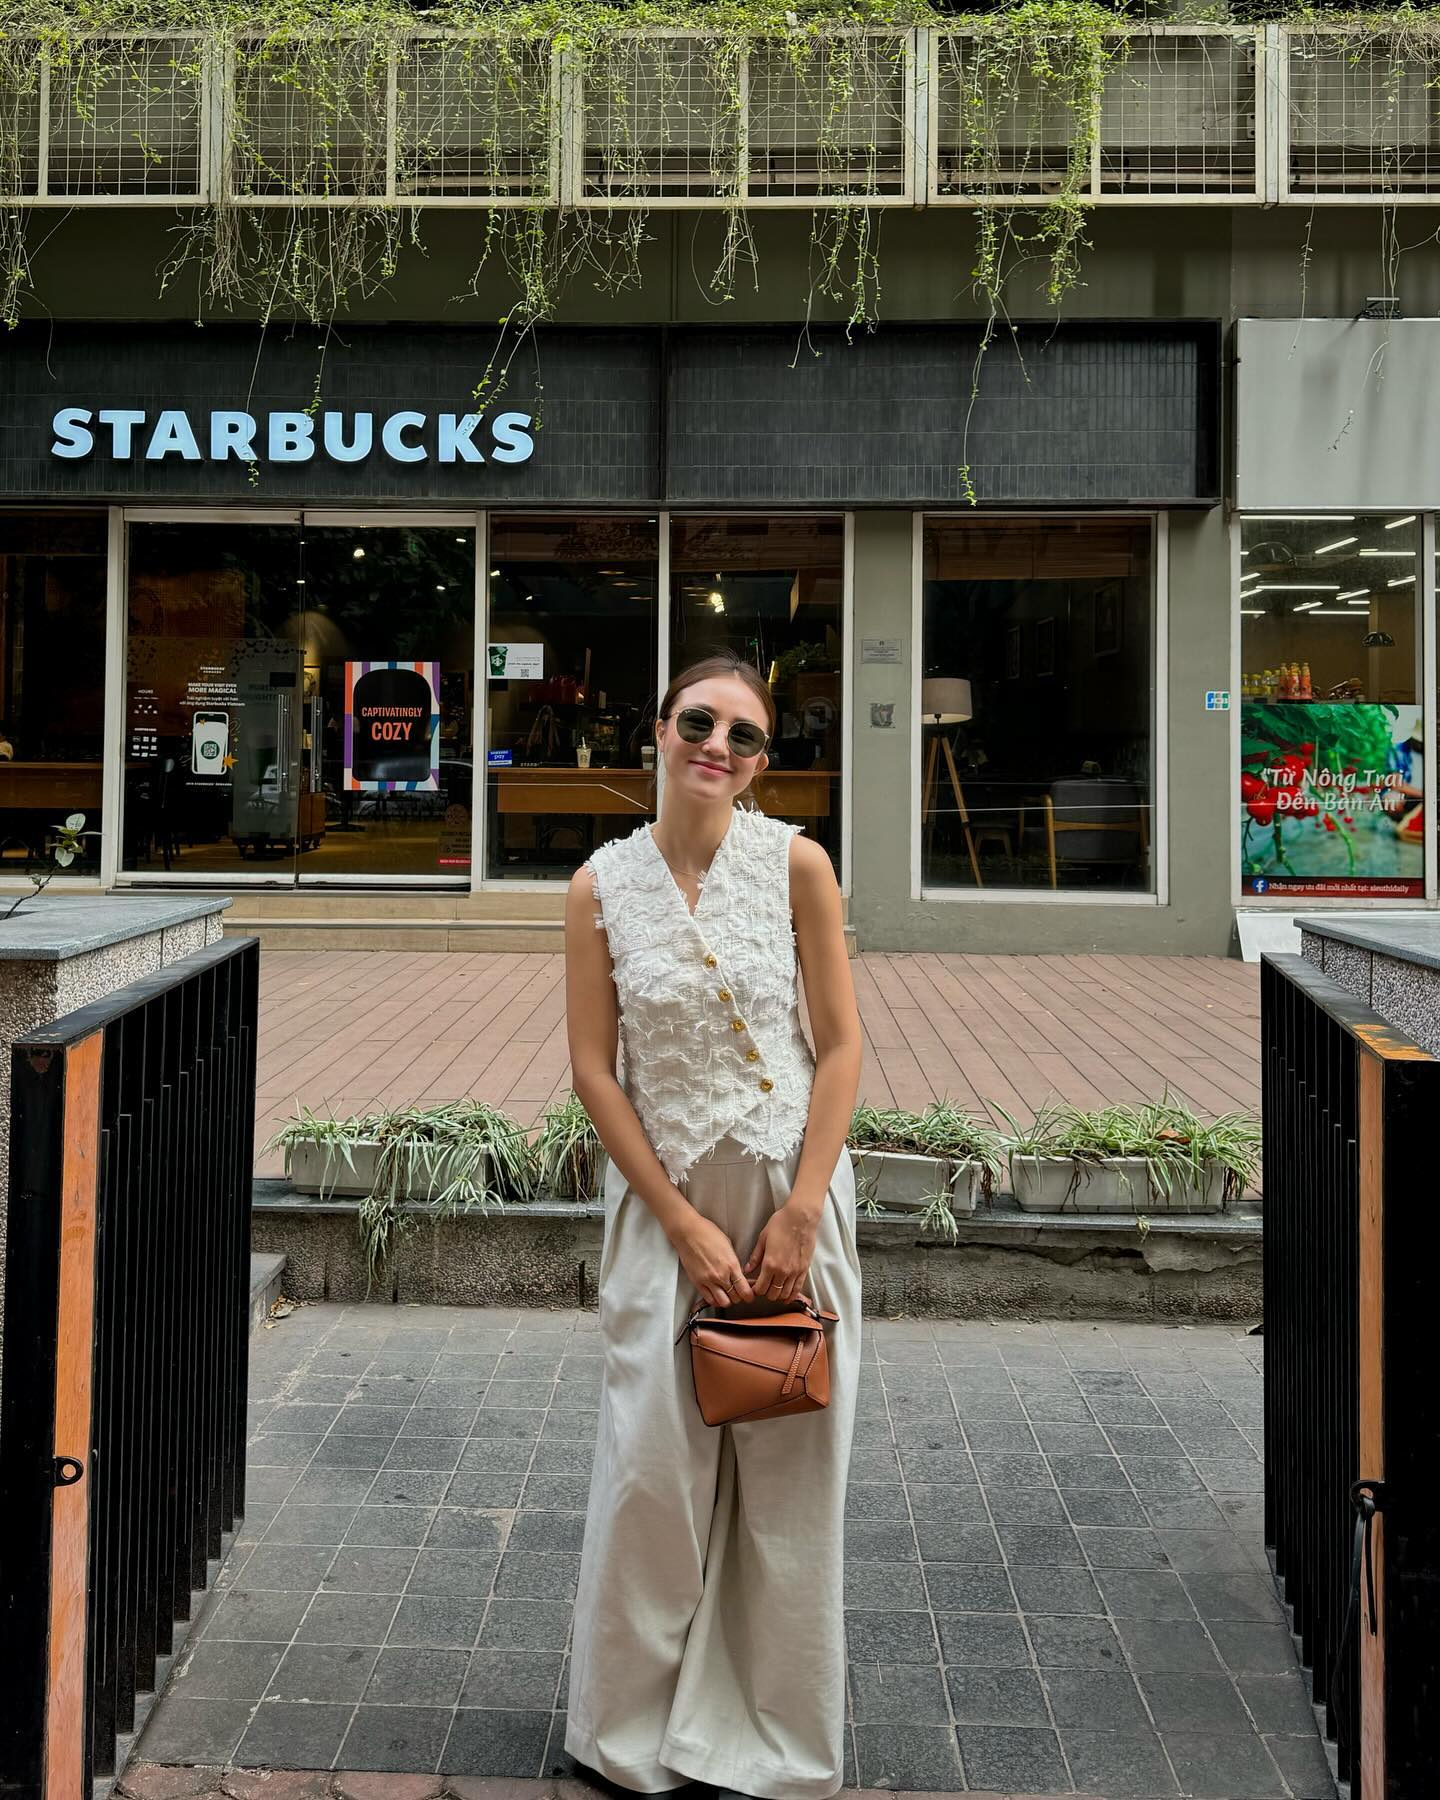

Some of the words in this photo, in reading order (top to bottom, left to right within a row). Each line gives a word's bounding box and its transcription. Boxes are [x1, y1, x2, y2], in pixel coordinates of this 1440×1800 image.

[51, 407, 534, 463] STARBUCKS
[361, 707, 423, 717] CAPTIVATINGLY
[371, 722, 412, 740] COZY
[1302, 768, 1357, 793] Nông
[1363, 768, 1404, 792] Trại
[1276, 787, 1316, 811] Đến
[1324, 790, 1362, 811] Bàn
[1288, 884, 1305, 892] ngay
